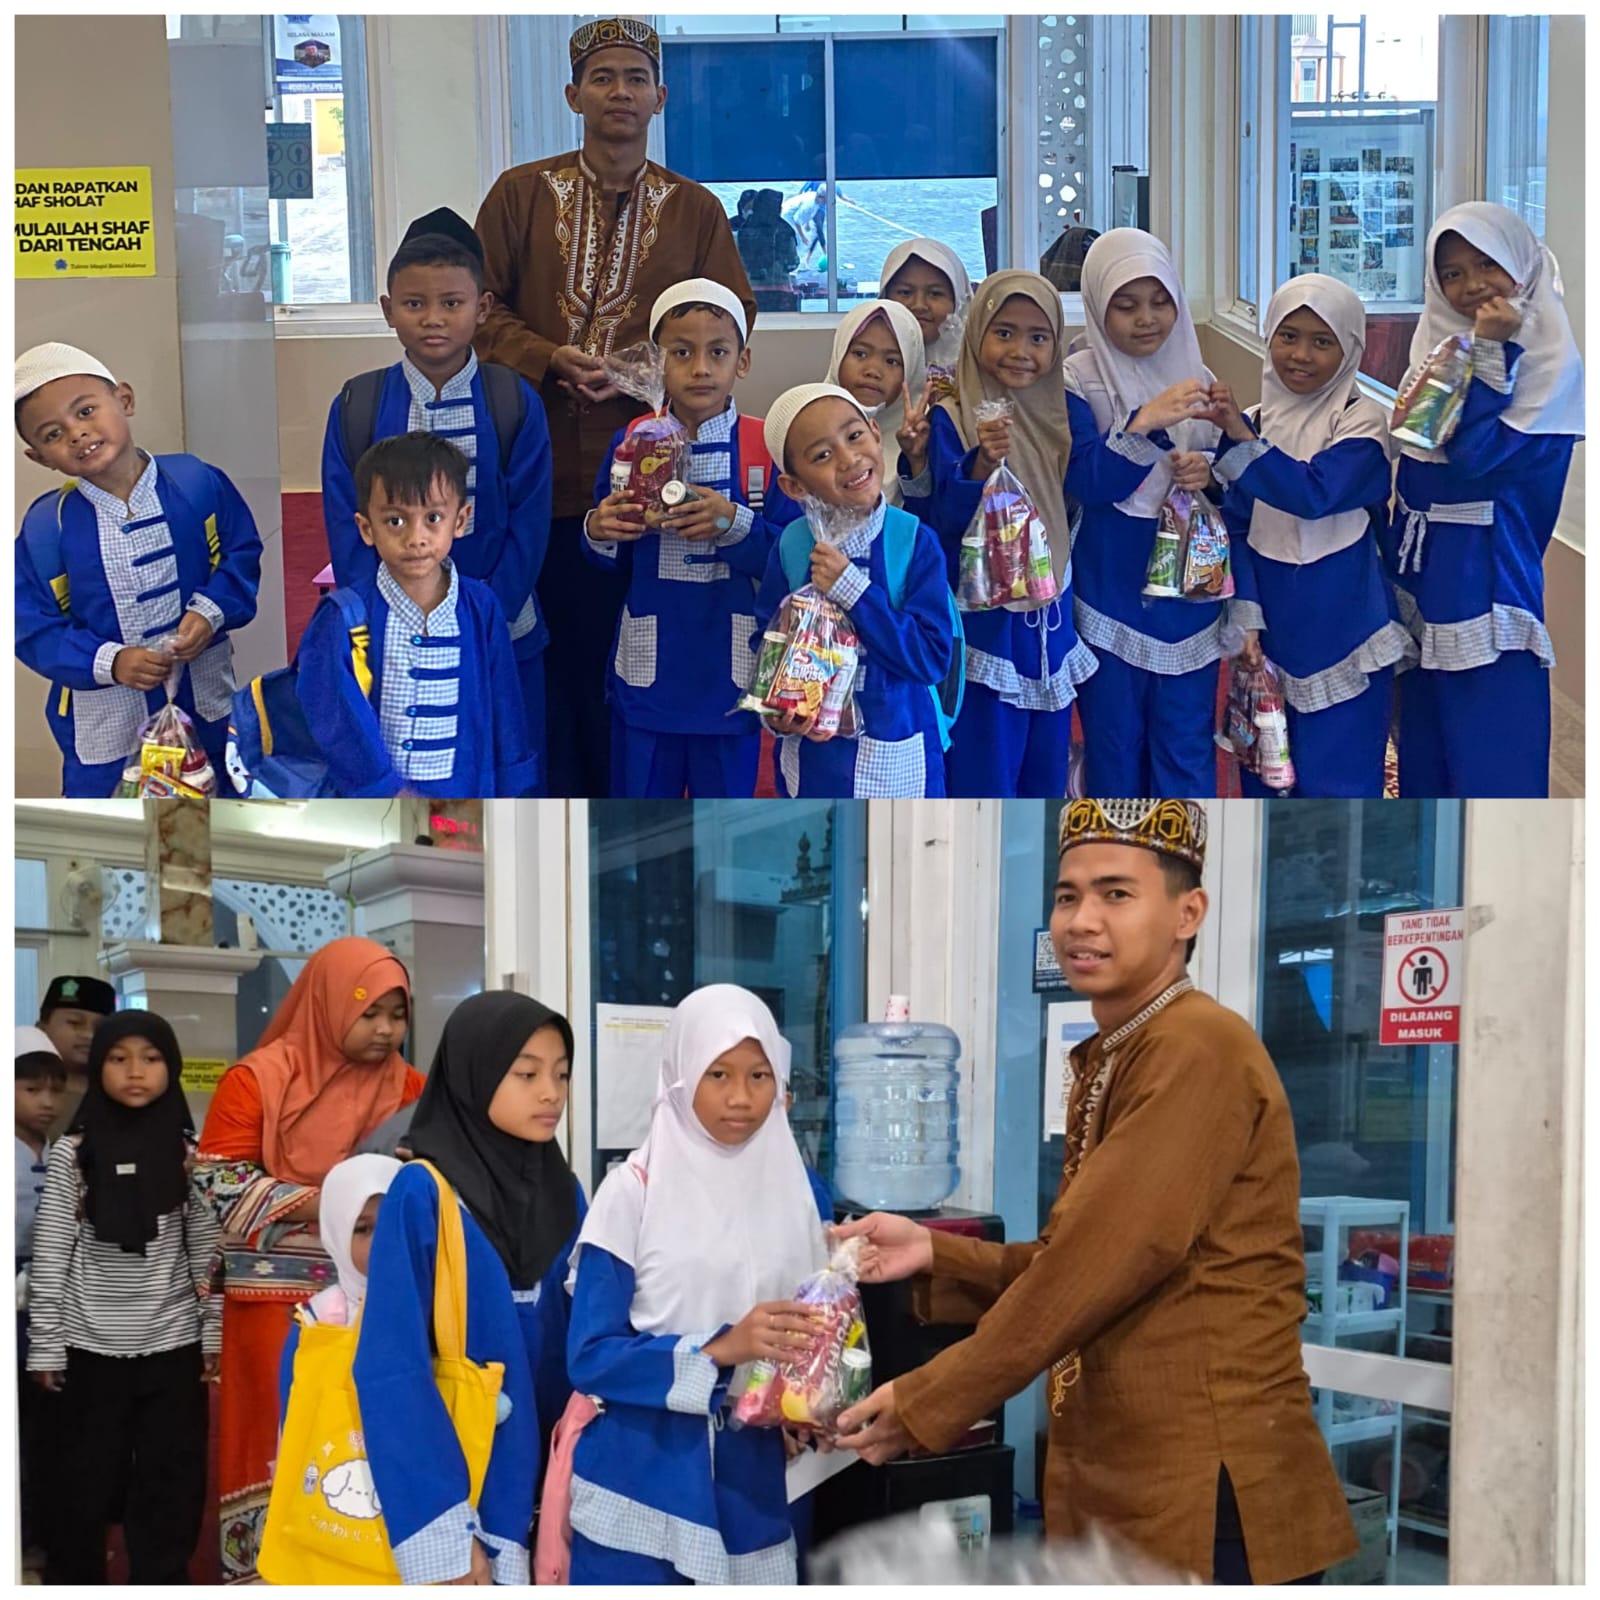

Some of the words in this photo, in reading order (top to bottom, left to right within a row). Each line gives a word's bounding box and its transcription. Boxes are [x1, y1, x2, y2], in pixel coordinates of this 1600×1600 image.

[15, 182, 49, 195] DAN
[53, 181, 138, 194] RAPATKAN
[43, 195, 105, 208] SHOLAT
[102, 220, 150, 235] SHAF
[19, 238, 63, 253] DARI
[66, 237, 141, 252] TENGAH
[1400, 918, 1422, 929] YANG
[1426, 915, 1451, 927] TIDAK
[1387, 929, 1464, 946] BERKEPENTINGAN
[1390, 1011, 1453, 1023] DILARANG
[1398, 1028, 1442, 1039] MASUK
